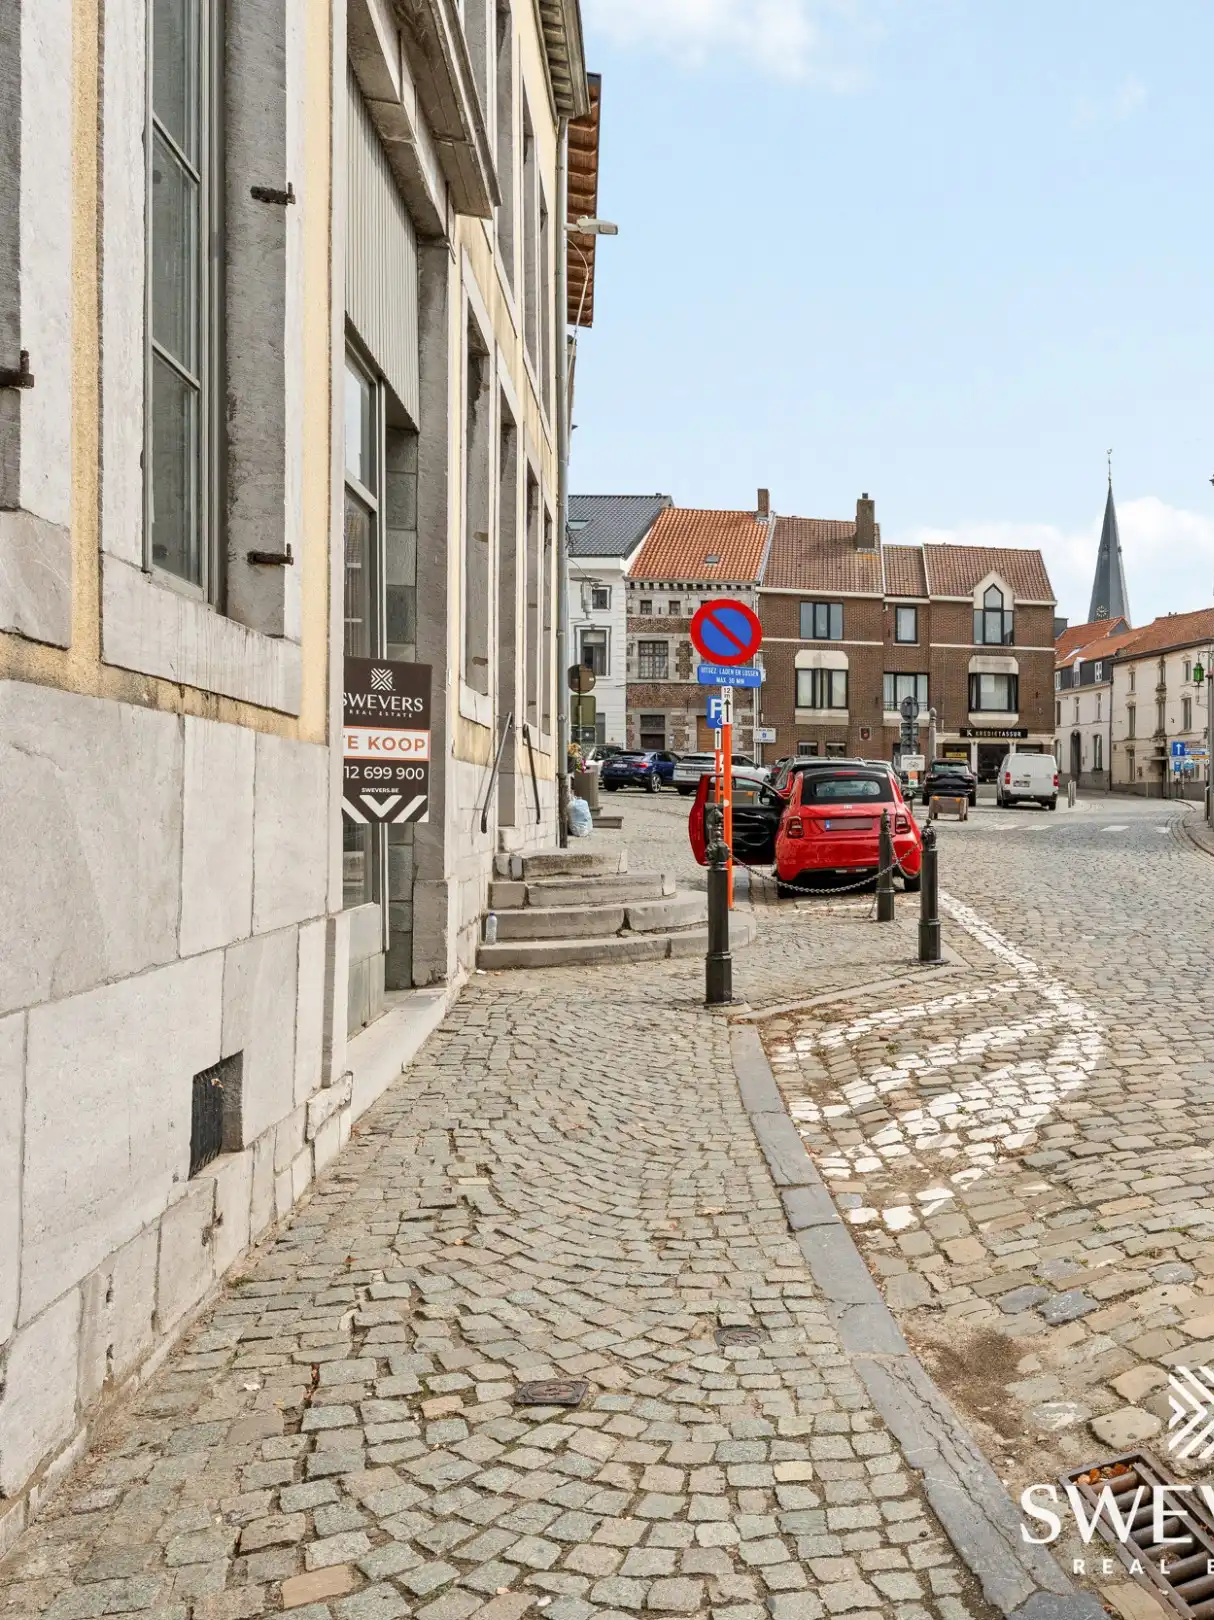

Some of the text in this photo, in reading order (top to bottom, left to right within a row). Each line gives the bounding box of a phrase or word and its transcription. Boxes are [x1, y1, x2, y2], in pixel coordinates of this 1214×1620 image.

[343, 735, 425, 752] E KOOP
[363, 766, 392, 780] 699
[395, 767, 425, 780] 900
